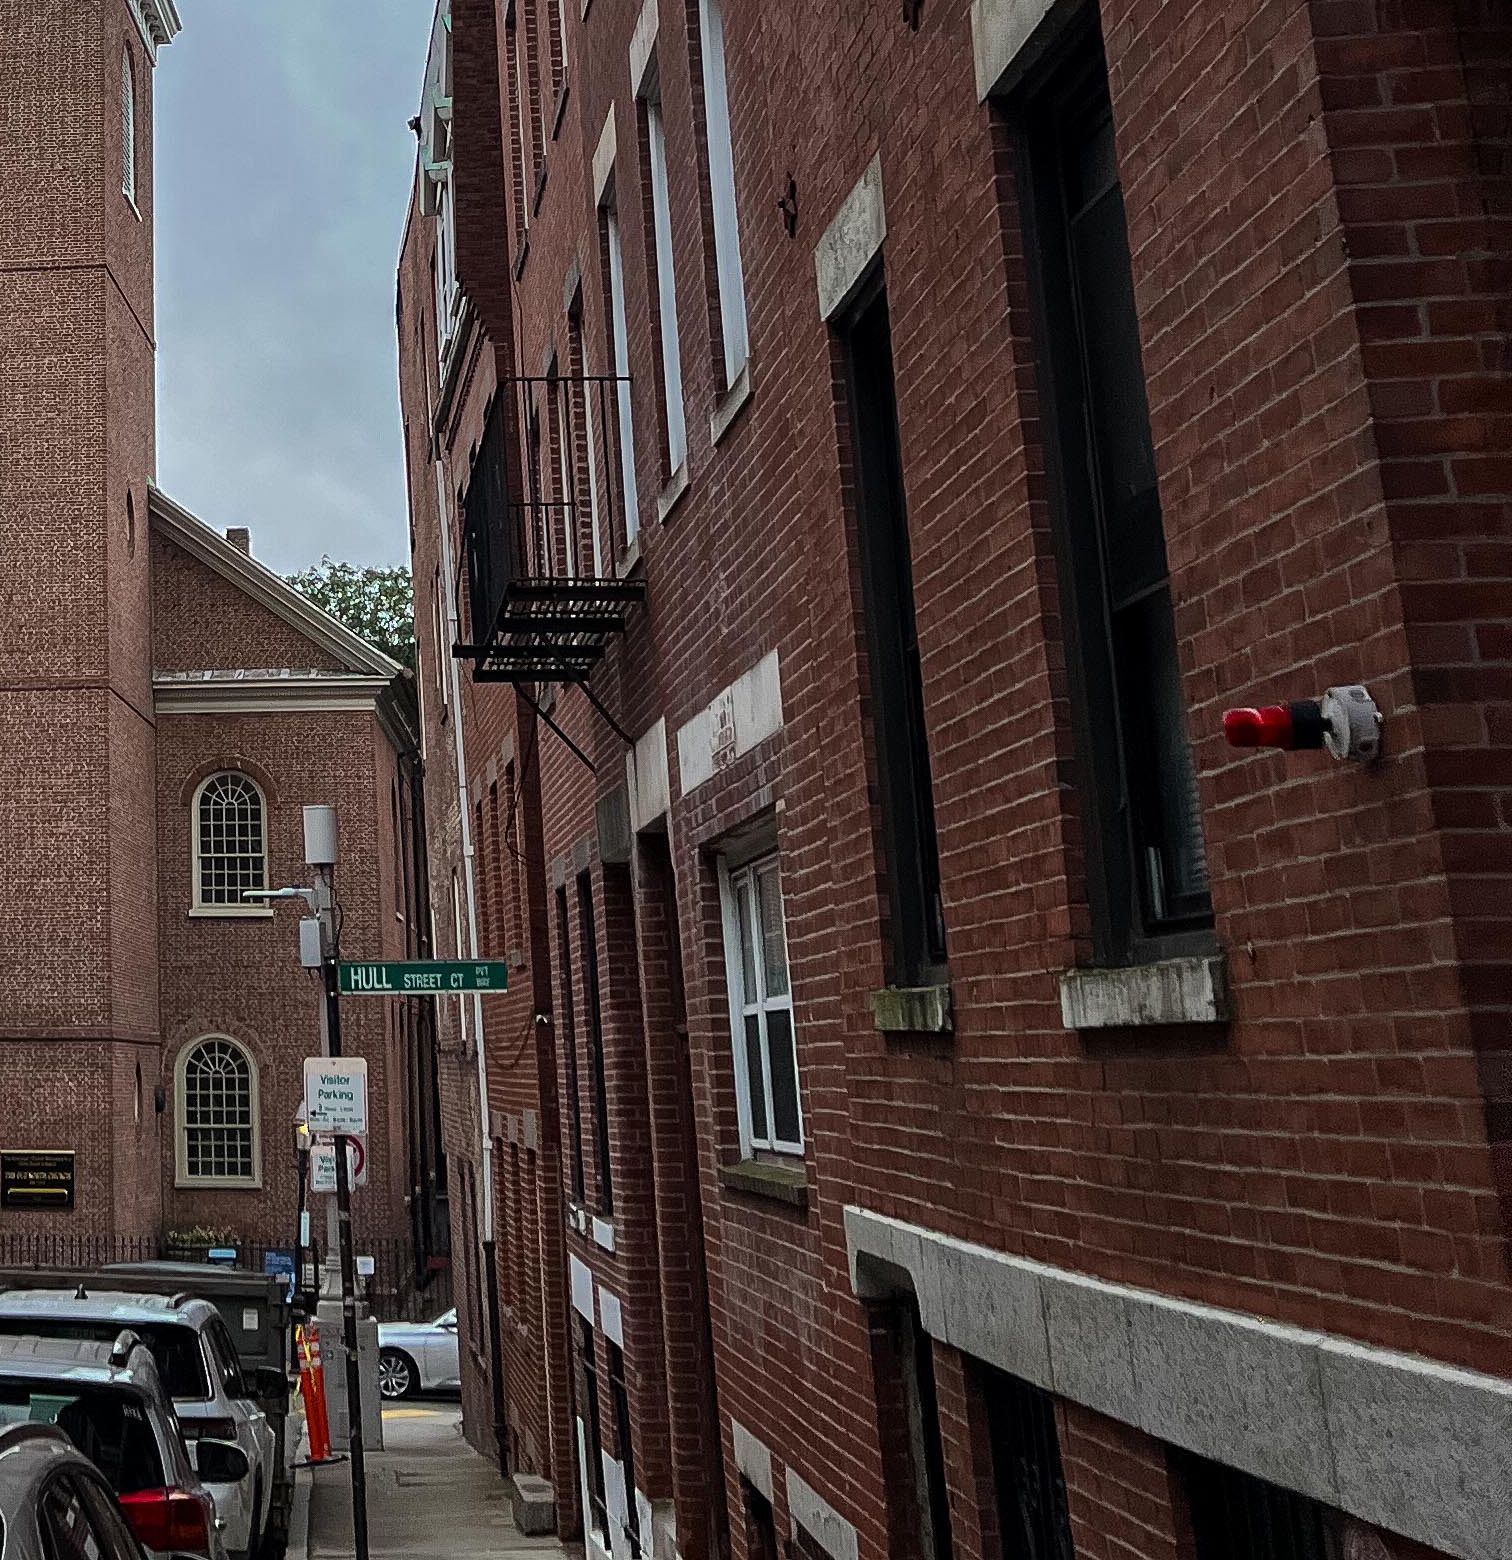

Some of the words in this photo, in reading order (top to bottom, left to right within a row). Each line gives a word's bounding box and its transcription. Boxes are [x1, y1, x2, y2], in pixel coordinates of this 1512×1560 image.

[350, 966, 393, 990] HULL
[403, 973, 442, 989] STREET
[450, 973, 464, 989] CT
[319, 1074, 350, 1086] Visitor
[317, 1088, 354, 1101] Parking
